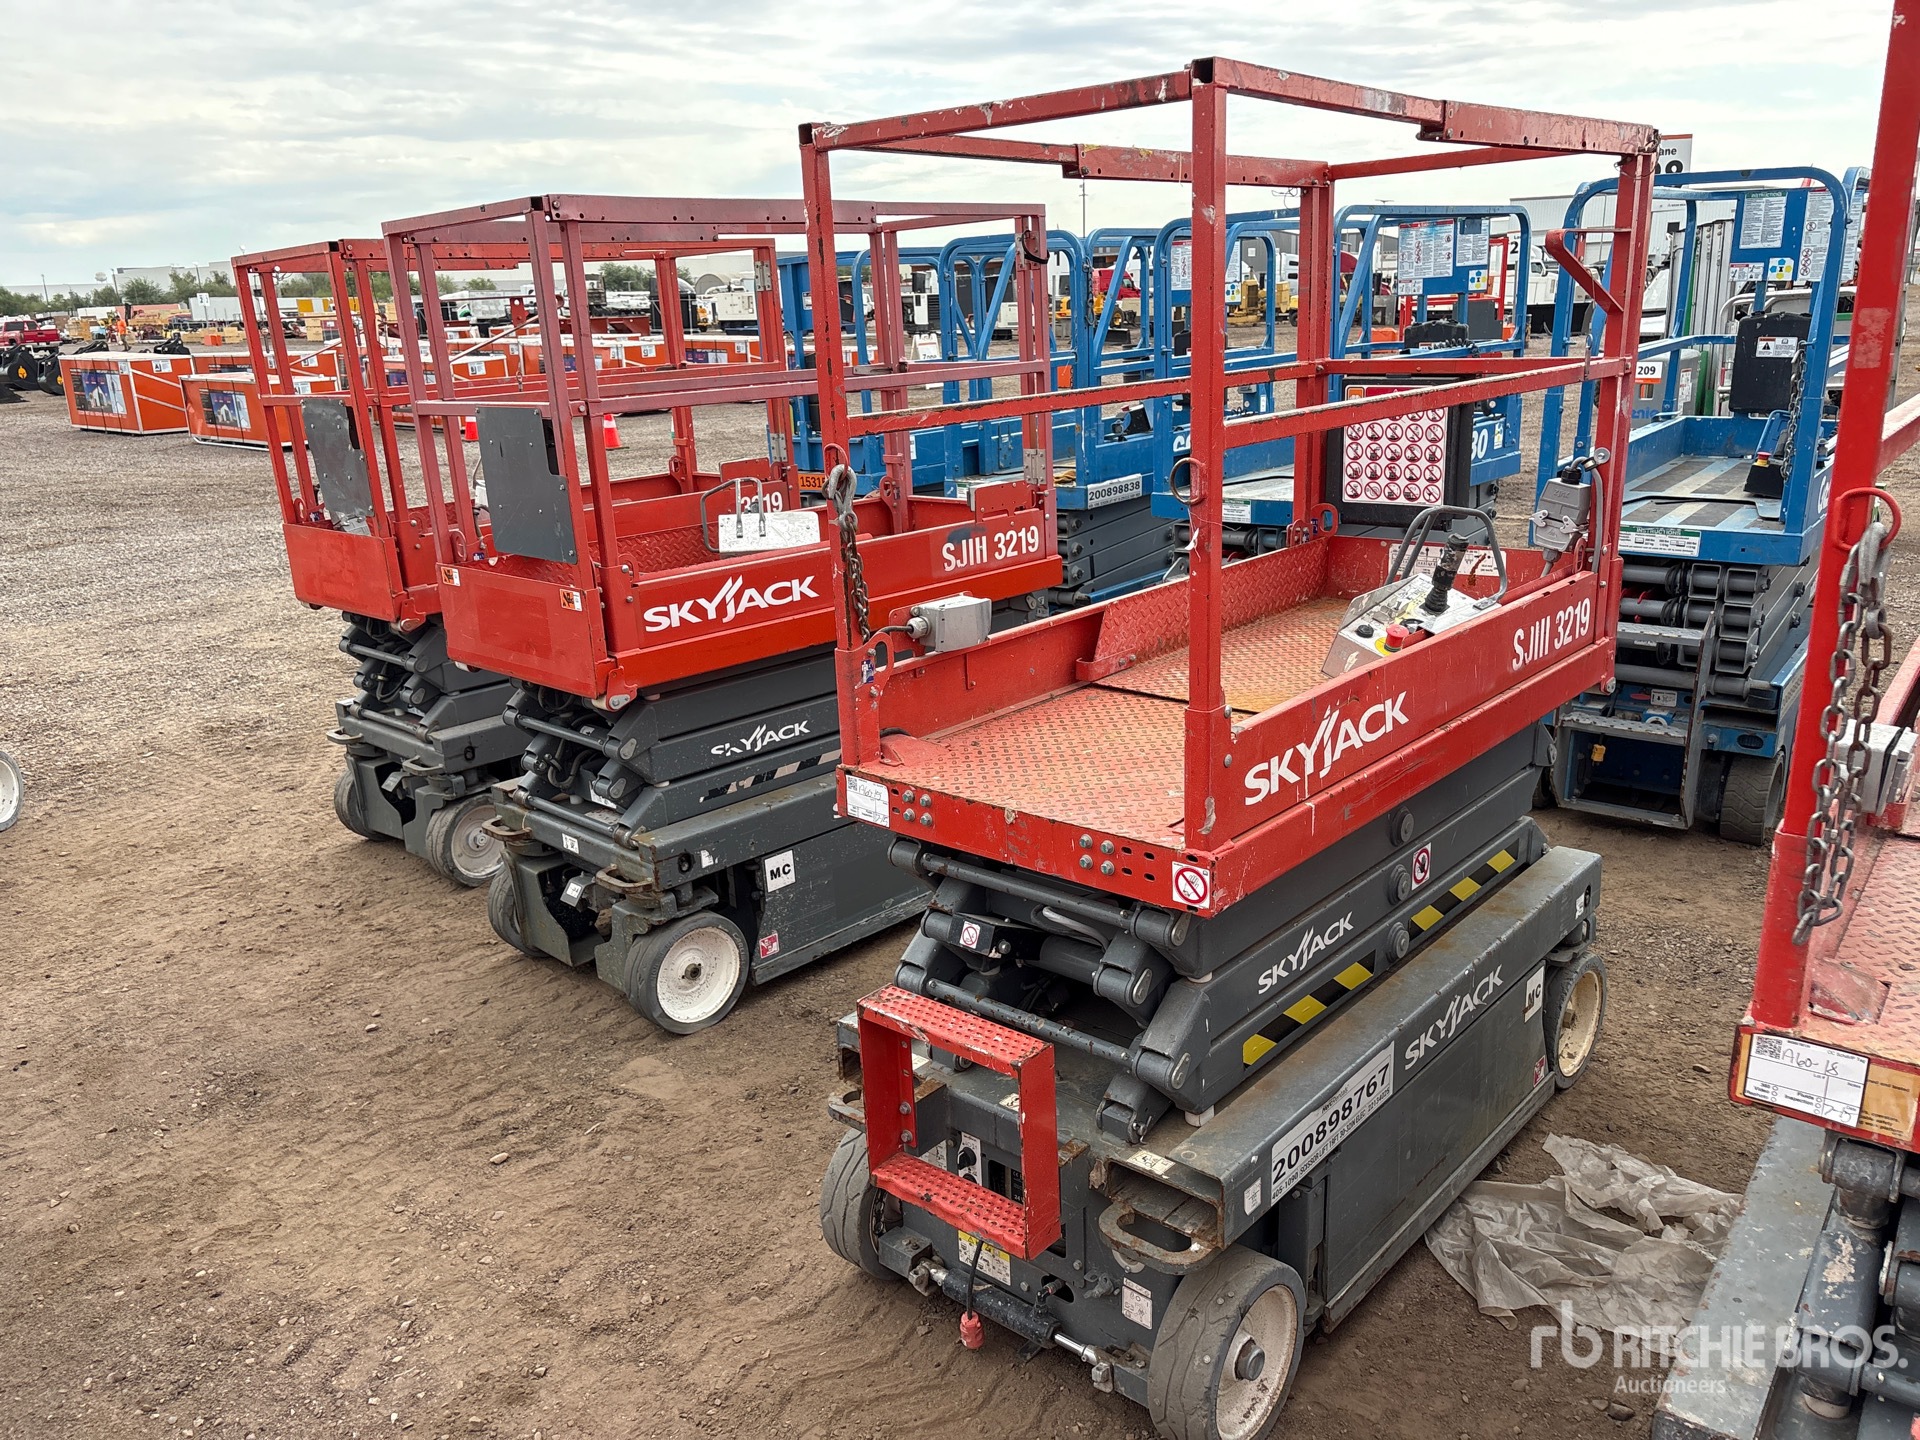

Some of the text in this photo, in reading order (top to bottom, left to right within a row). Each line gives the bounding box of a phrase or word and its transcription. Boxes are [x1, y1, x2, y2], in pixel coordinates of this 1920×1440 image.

[1637, 365, 1656, 375] 209
[1089, 480, 1140, 501] 200898838
[993, 525, 1039, 561] 3219
[643, 575, 820, 632] SKYJACK
[1553, 597, 1592, 650] 3219
[1244, 690, 1410, 806] SKYJACK
[769, 863, 792, 881] MC
[1258, 911, 1354, 995] SKYJACK
[1404, 964, 1504, 1071] SKYJACK
[1272, 1062, 1390, 1186] 200898767
[1271, 1170, 1299, 1199] 405-1090
[1319, 1144, 1329, 1159] LIFT
